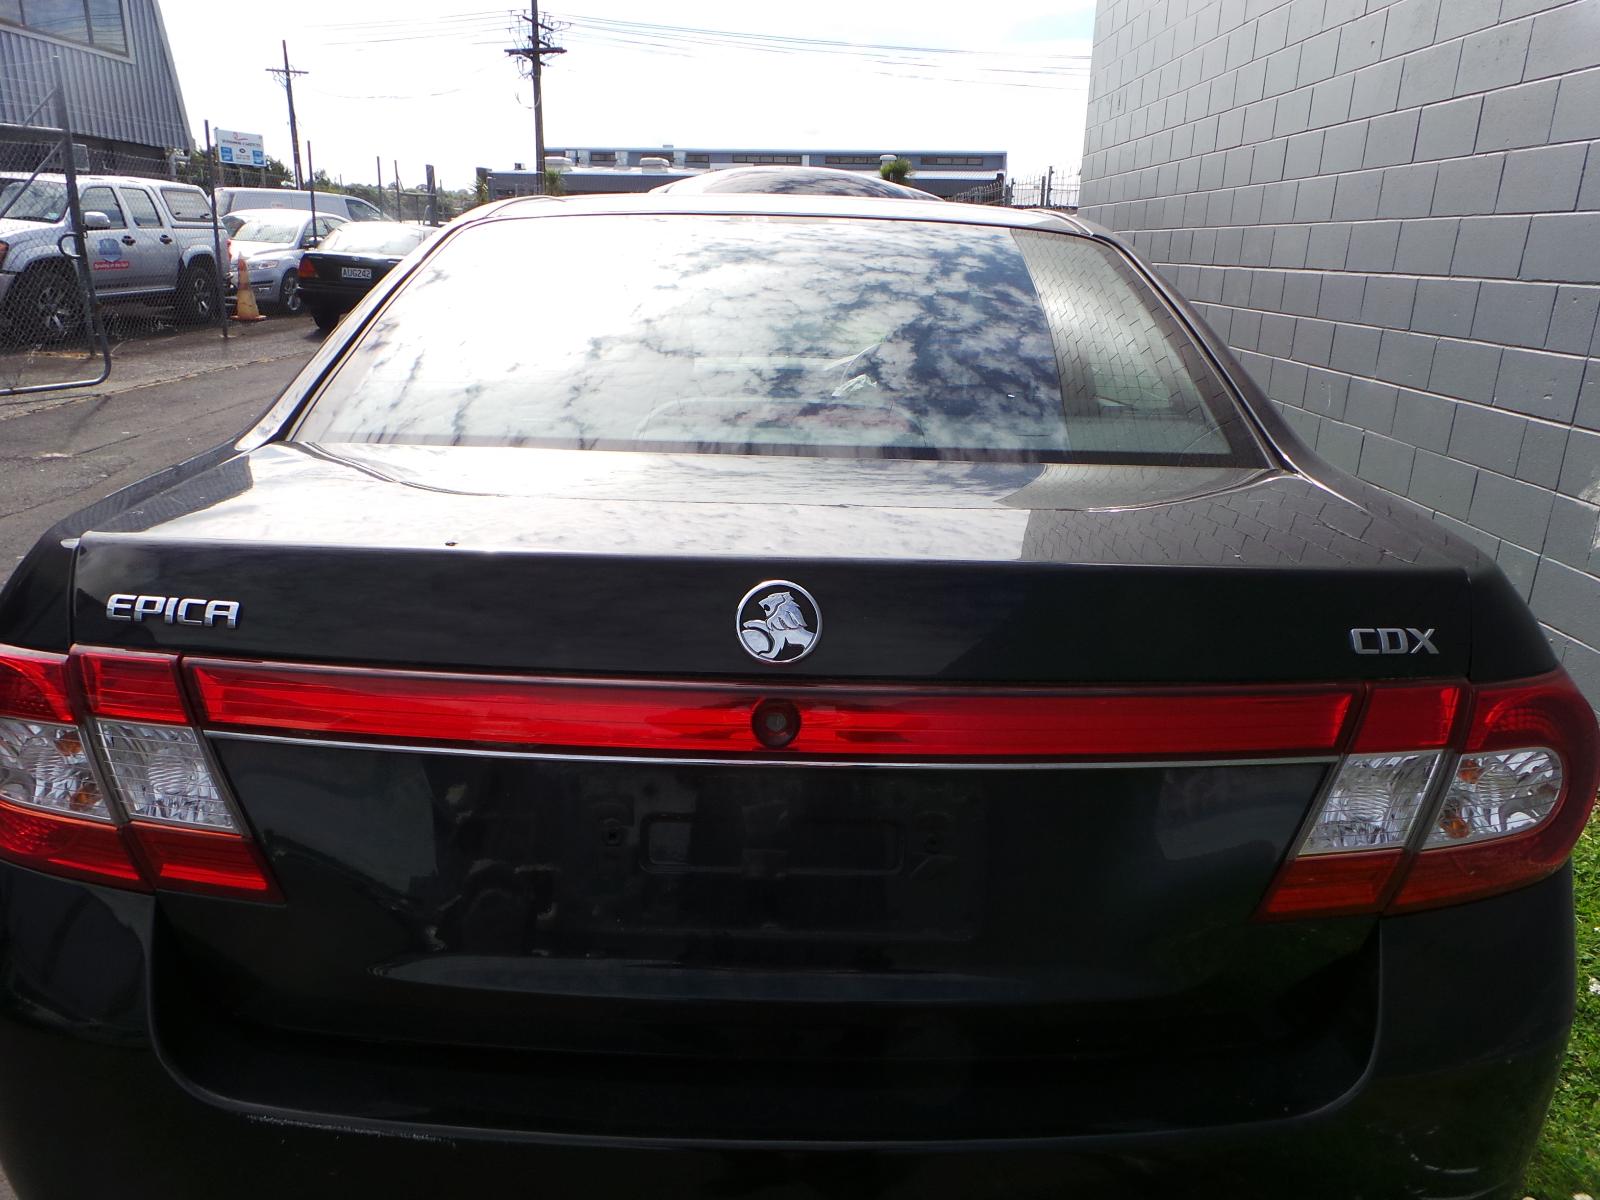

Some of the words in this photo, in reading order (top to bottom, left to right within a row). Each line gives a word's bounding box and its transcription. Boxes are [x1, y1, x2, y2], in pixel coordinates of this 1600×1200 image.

[342, 268, 371, 278] AUG242
[106, 594, 239, 628] EPICA
[1350, 628, 1440, 654] CDX
